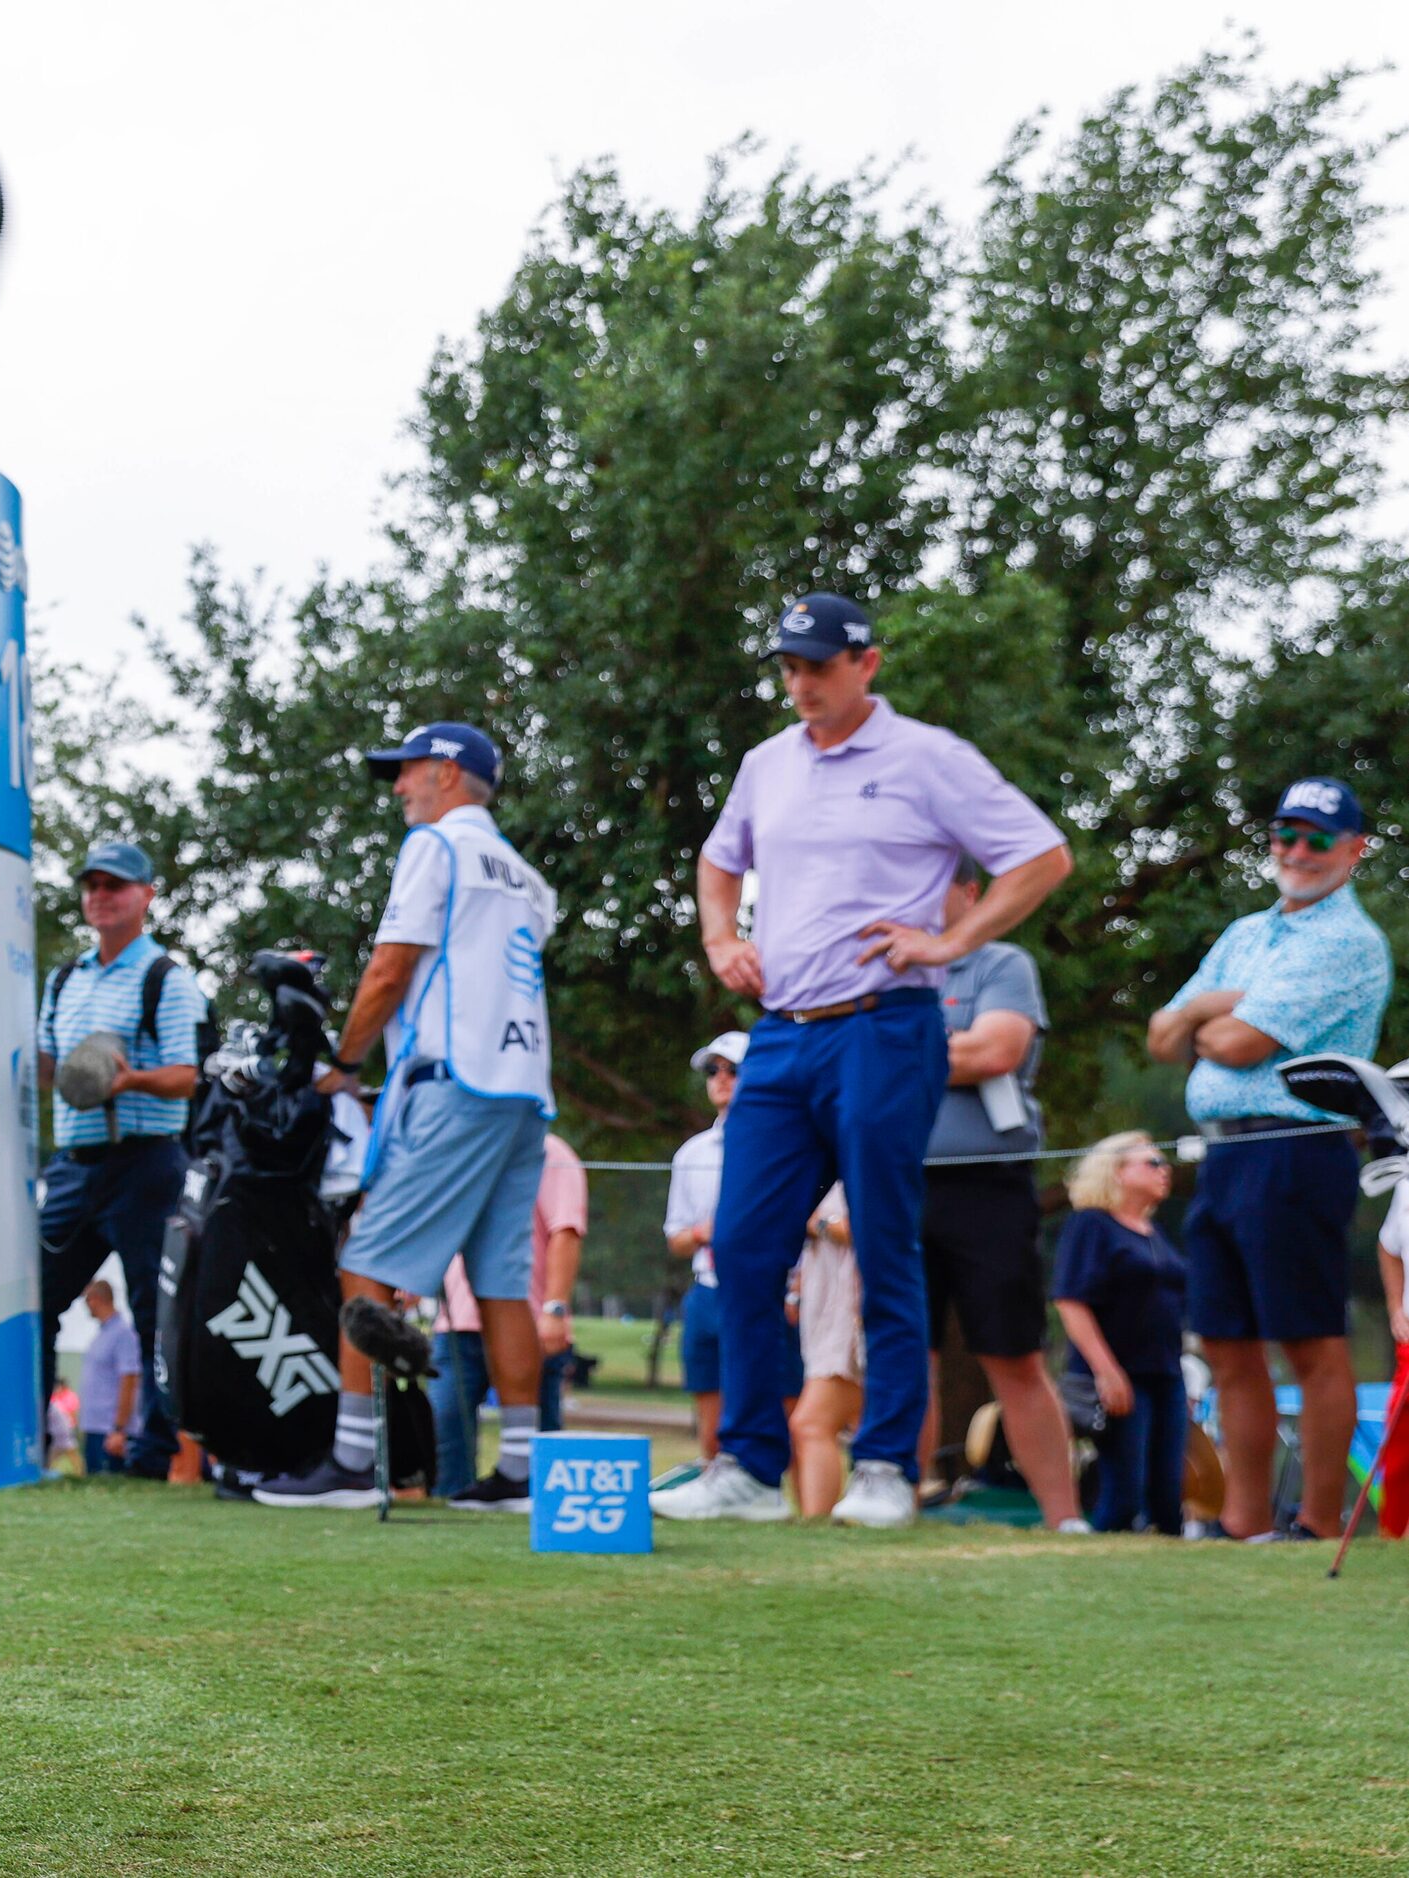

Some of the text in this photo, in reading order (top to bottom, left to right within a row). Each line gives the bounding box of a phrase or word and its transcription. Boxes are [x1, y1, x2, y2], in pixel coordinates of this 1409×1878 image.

[205, 1259, 341, 1418] PXG
[543, 1459, 641, 1493] AT&T
[552, 1494, 628, 1534] 5G
